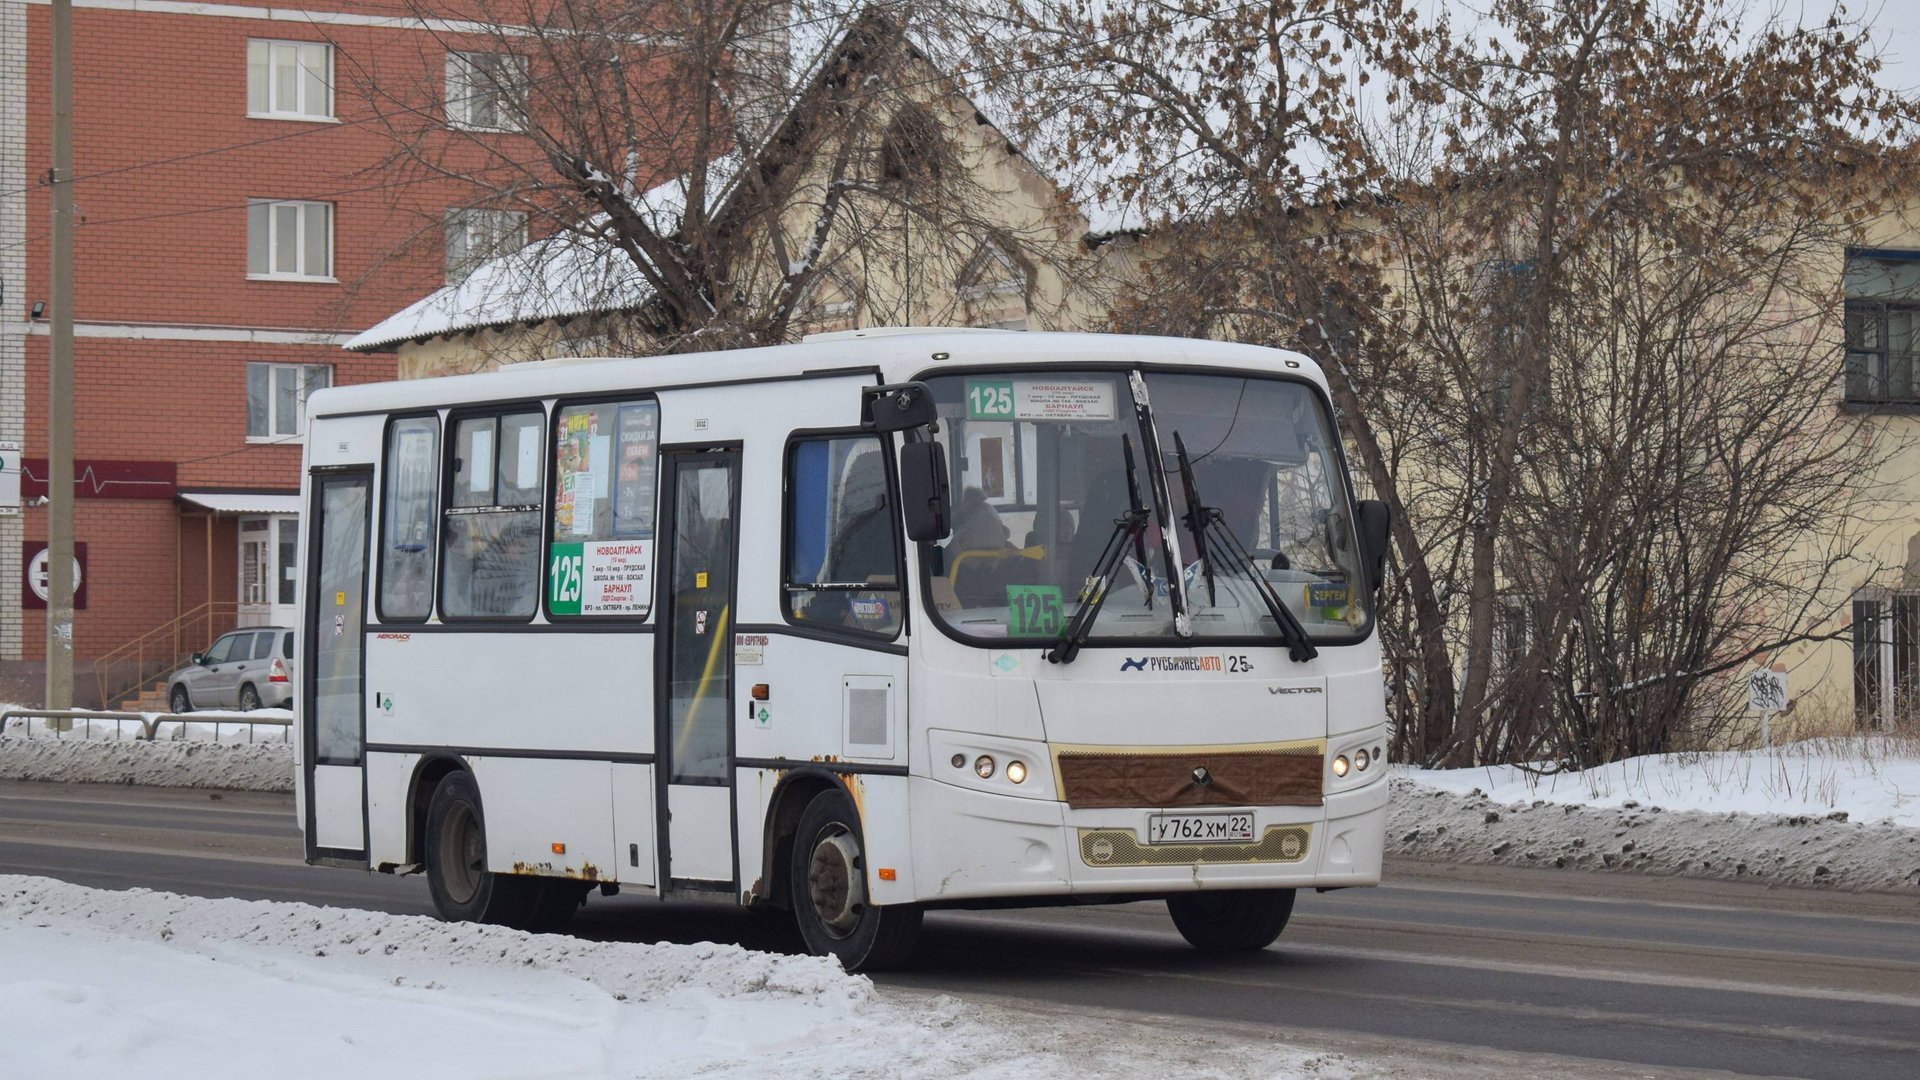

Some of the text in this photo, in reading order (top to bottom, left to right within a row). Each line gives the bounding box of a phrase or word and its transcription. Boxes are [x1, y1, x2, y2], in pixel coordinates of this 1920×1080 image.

[970, 386, 1012, 414] 125
[596, 544, 642, 555] НОВОАЛТАЙСК
[623, 564, 646, 572] ПРУДСКАЯ
[551, 555, 582, 602] 125
[603, 584, 632, 593] БАРНАУЛ
[1013, 592, 1060, 635] 125
[1228, 655, 1249, 673] 25
[1231, 817, 1248, 832] 22
